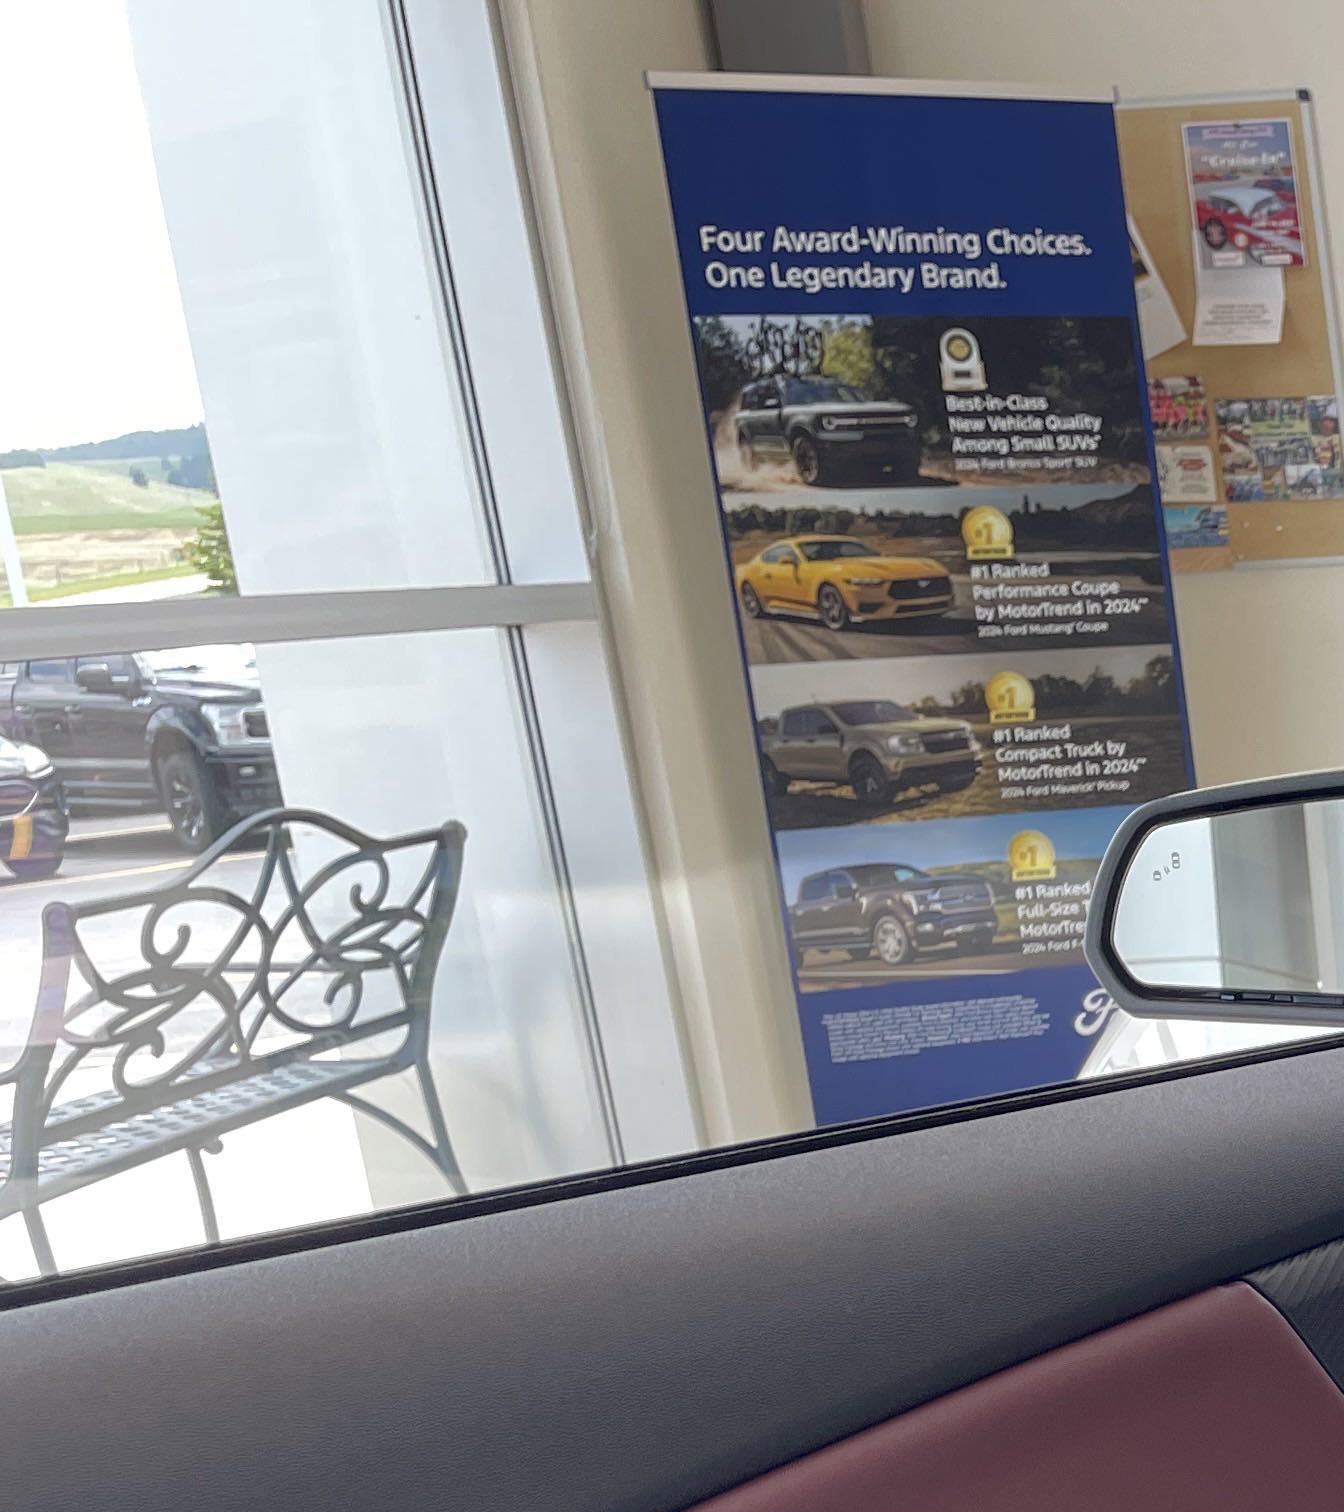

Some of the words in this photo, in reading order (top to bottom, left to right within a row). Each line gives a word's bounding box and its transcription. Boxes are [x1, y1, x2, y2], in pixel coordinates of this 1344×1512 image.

[699, 225, 764, 253] Four
[772, 226, 981, 259] Award-Winning
[987, 228, 1092, 256] Choices.
[705, 261, 764, 289] One
[771, 262, 914, 293] Legendary
[921, 262, 1007, 290] Brand.
[945, 394, 1049, 412] Best-in-Class
[949, 416, 986, 432] New
[987, 415, 1045, 432] Vehicle
[1045, 413, 1102, 433] Quality
[952, 437, 1010, 455] Among
[1011, 435, 1055, 452] Small
[971, 564, 989, 580] #1
[991, 562, 1050, 579] Ranked
[973, 583, 1069, 601] Performance
[1071, 580, 1121, 598] Coupe
[975, 604, 995, 622] by
[998, 600, 1083, 619] MotorTrend
[1086, 600, 1101, 615] in
[993, 728, 1012, 743] #1
[1014, 724, 1072, 742] Ranked
[995, 744, 1063, 763] Compact
[1064, 741, 1105, 757] Truck
[1106, 739, 1127, 757] by
[998, 762, 1083, 782] MotorTrend
[1085, 760, 1101, 776] in
[1015, 885, 1033, 901] #1
[1035, 880, 1092, 899] Ranked
[1017, 900, 1080, 920] Full-Size
[1020, 919, 1087, 939] MotorTre
[1047, 940, 1070, 953] Ford
